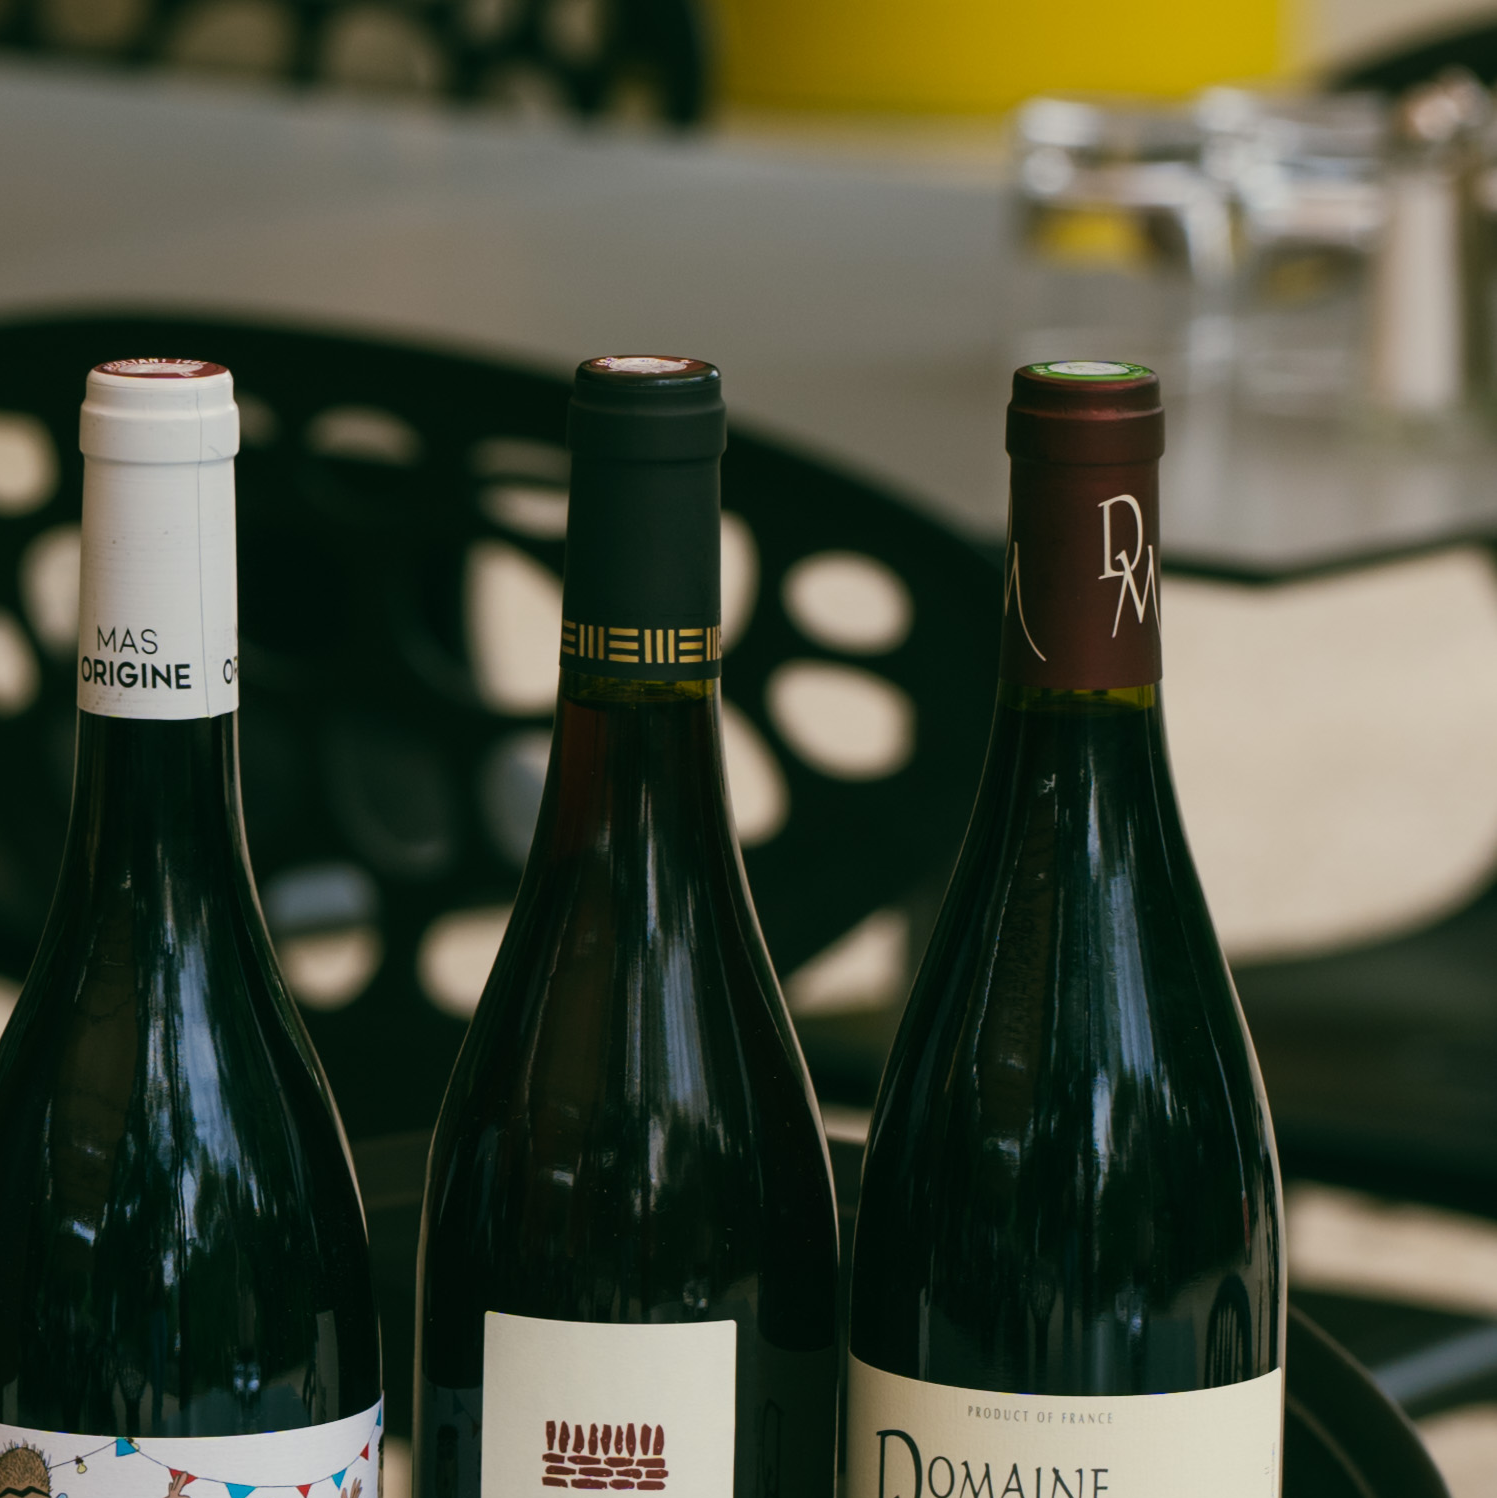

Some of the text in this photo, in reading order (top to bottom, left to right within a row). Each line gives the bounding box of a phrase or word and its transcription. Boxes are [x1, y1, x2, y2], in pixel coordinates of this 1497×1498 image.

[97, 624, 158, 654] MAS
[81, 655, 192, 690] ORIGINE
[967, 1405, 1114, 1424] PRODUCT OF FRANCE
